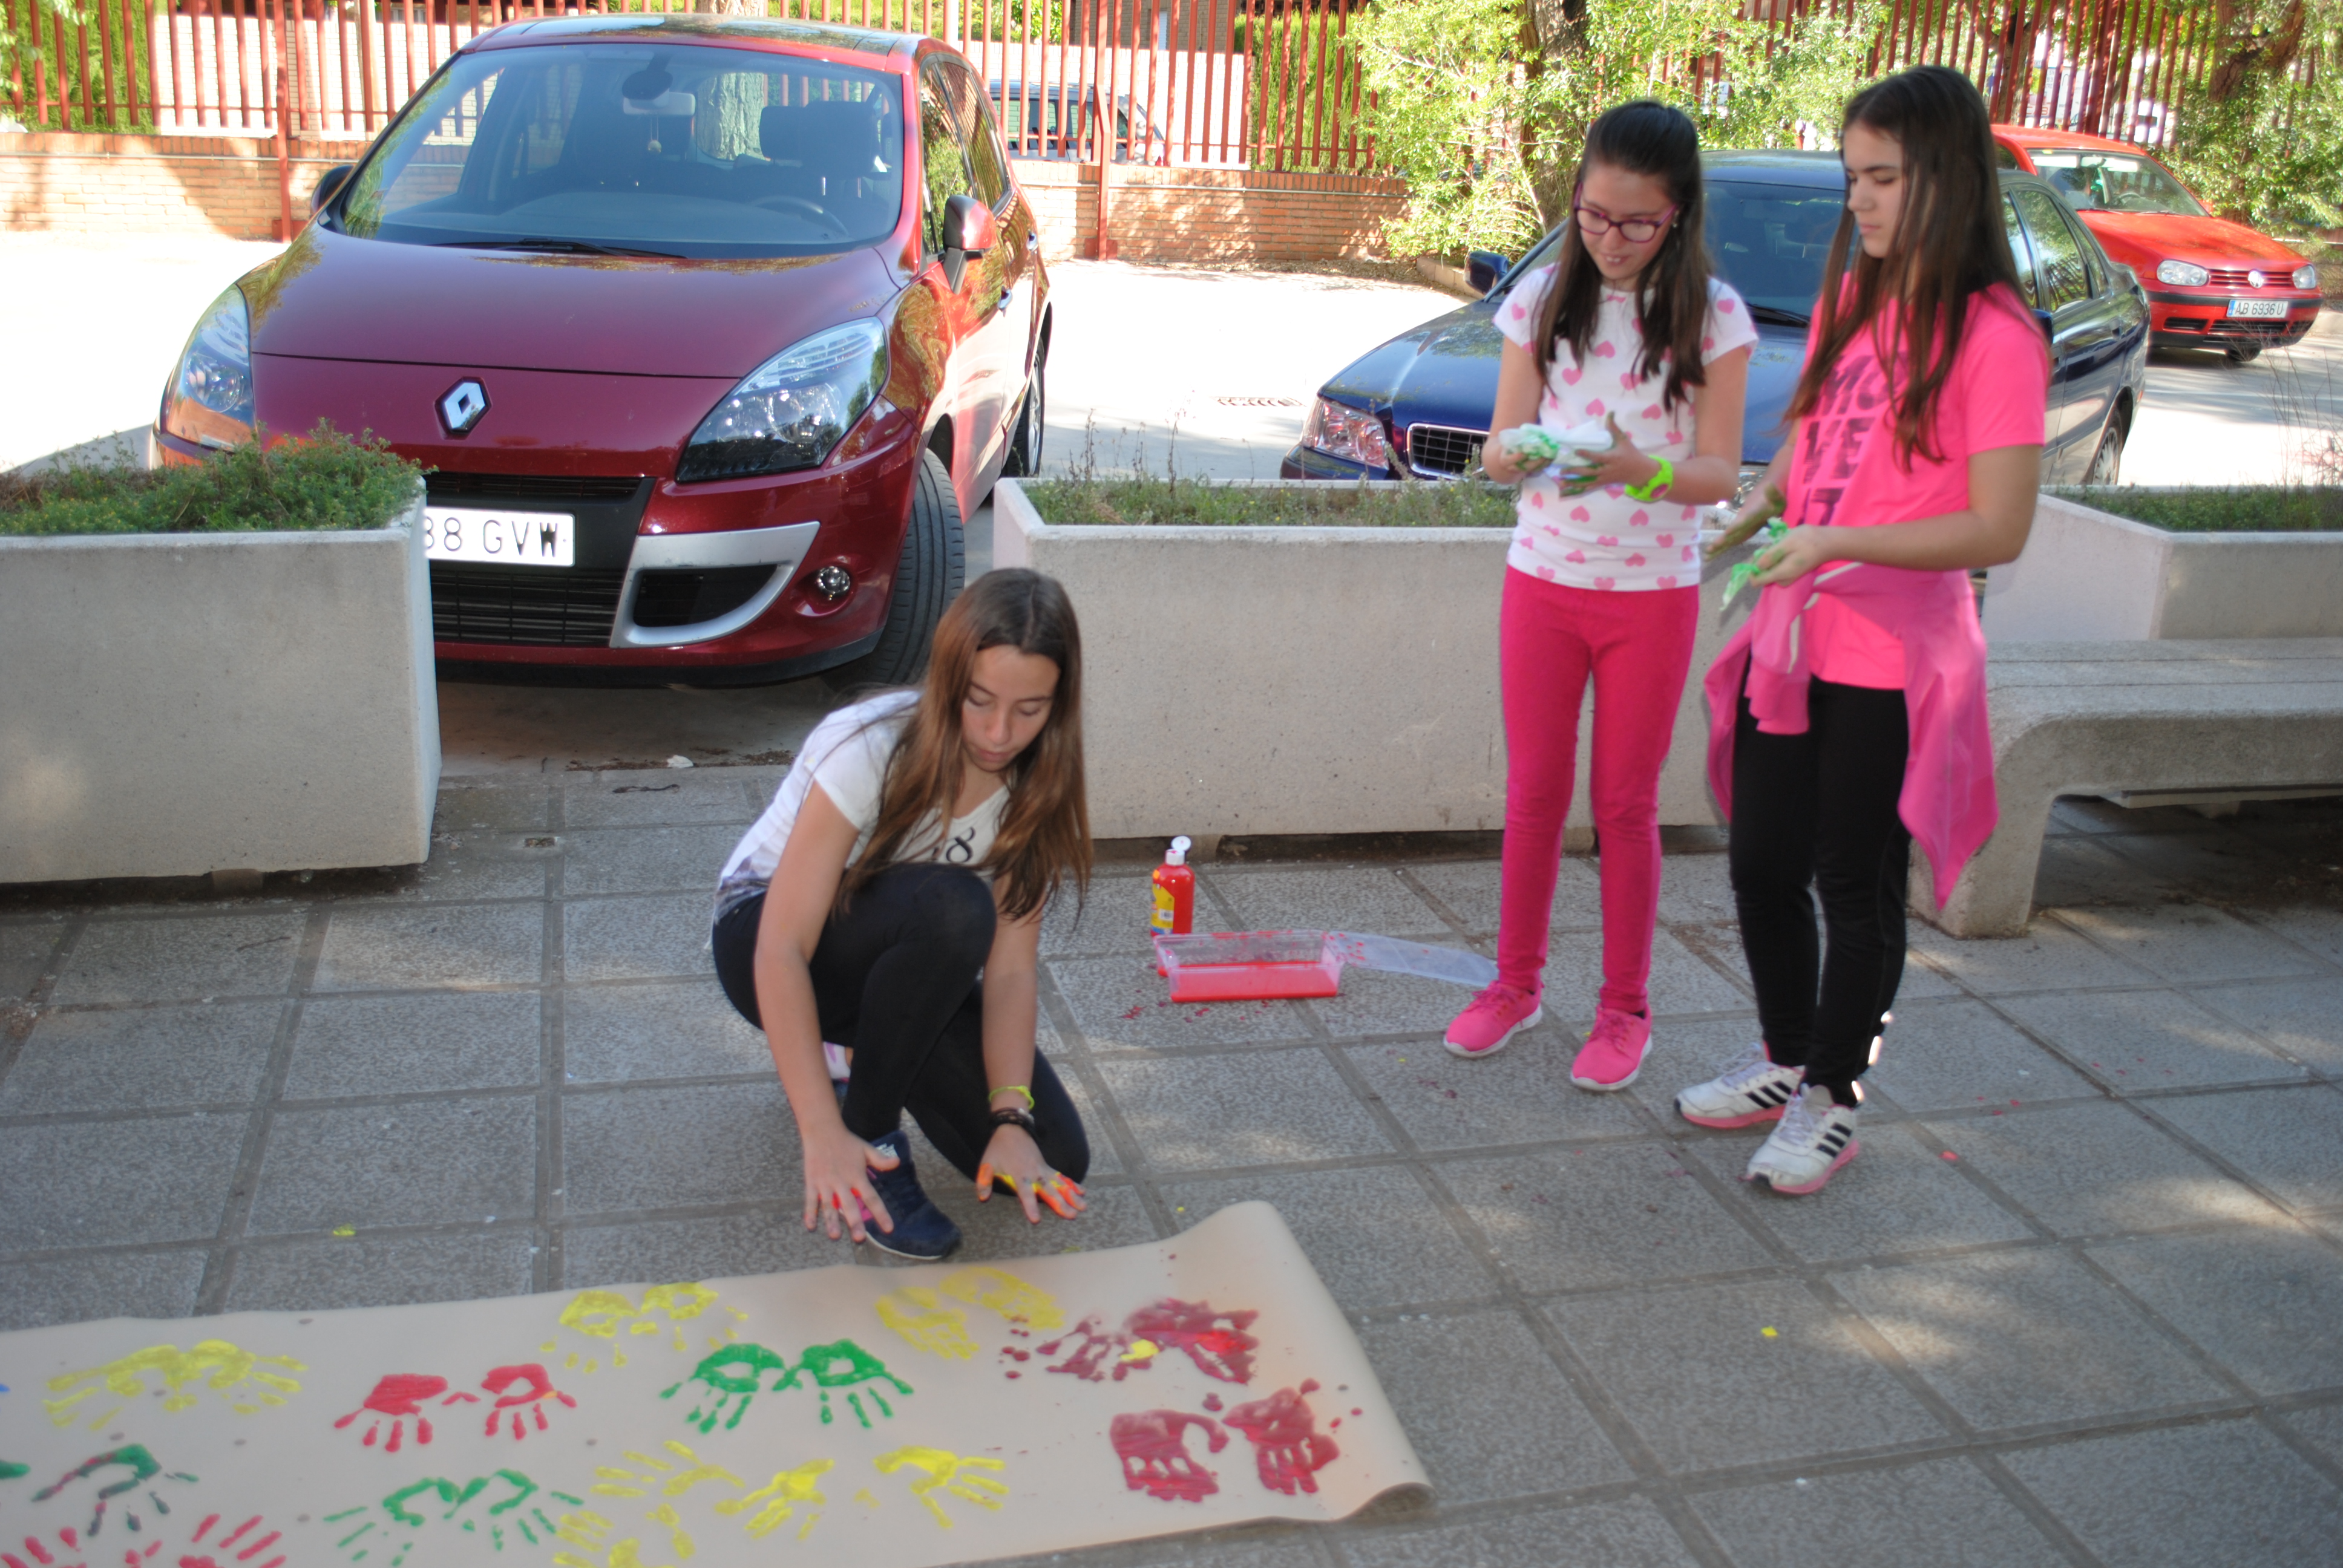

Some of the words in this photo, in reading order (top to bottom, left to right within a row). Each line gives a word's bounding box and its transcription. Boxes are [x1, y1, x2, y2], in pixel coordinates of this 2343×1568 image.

[2235, 302, 2249, 315] AB
[2252, 303, 2276, 315] 6936
[2276, 303, 2284, 315] U
[482, 519, 558, 558] GVW
